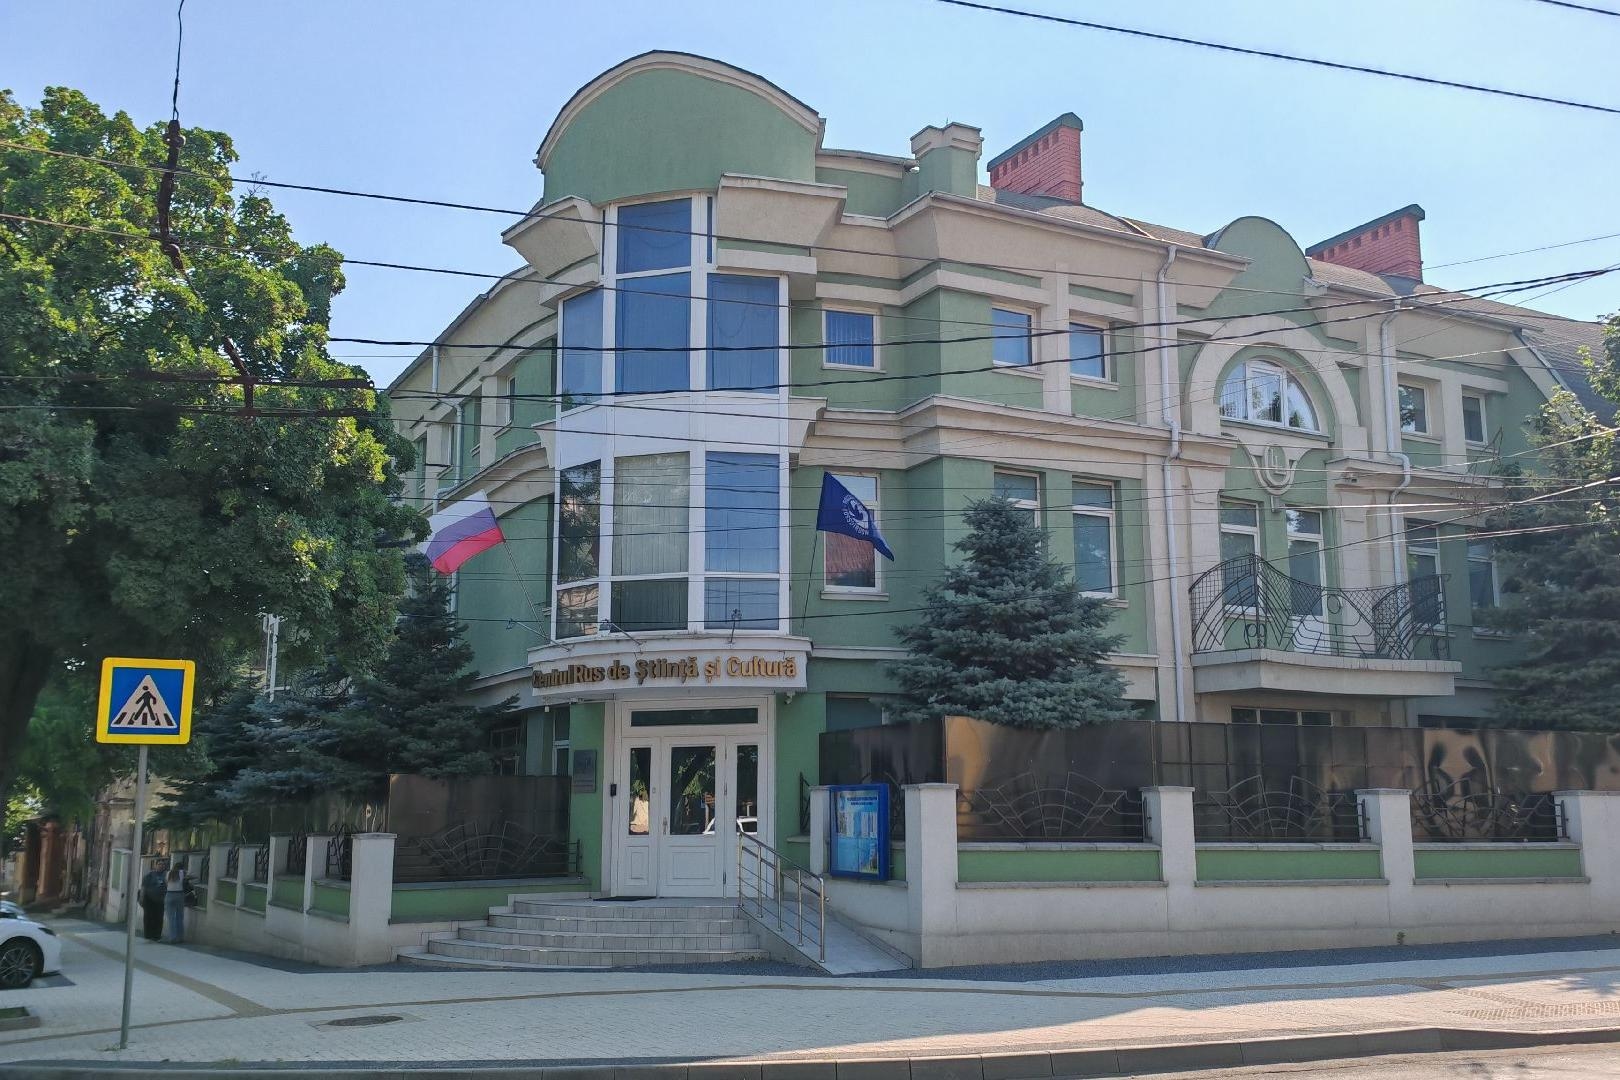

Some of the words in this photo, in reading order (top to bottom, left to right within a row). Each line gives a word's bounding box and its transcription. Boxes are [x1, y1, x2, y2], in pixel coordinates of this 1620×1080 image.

[574, 664, 606, 683] Rus
[607, 659, 631, 681] de
[726, 656, 797, 678] Cultură
